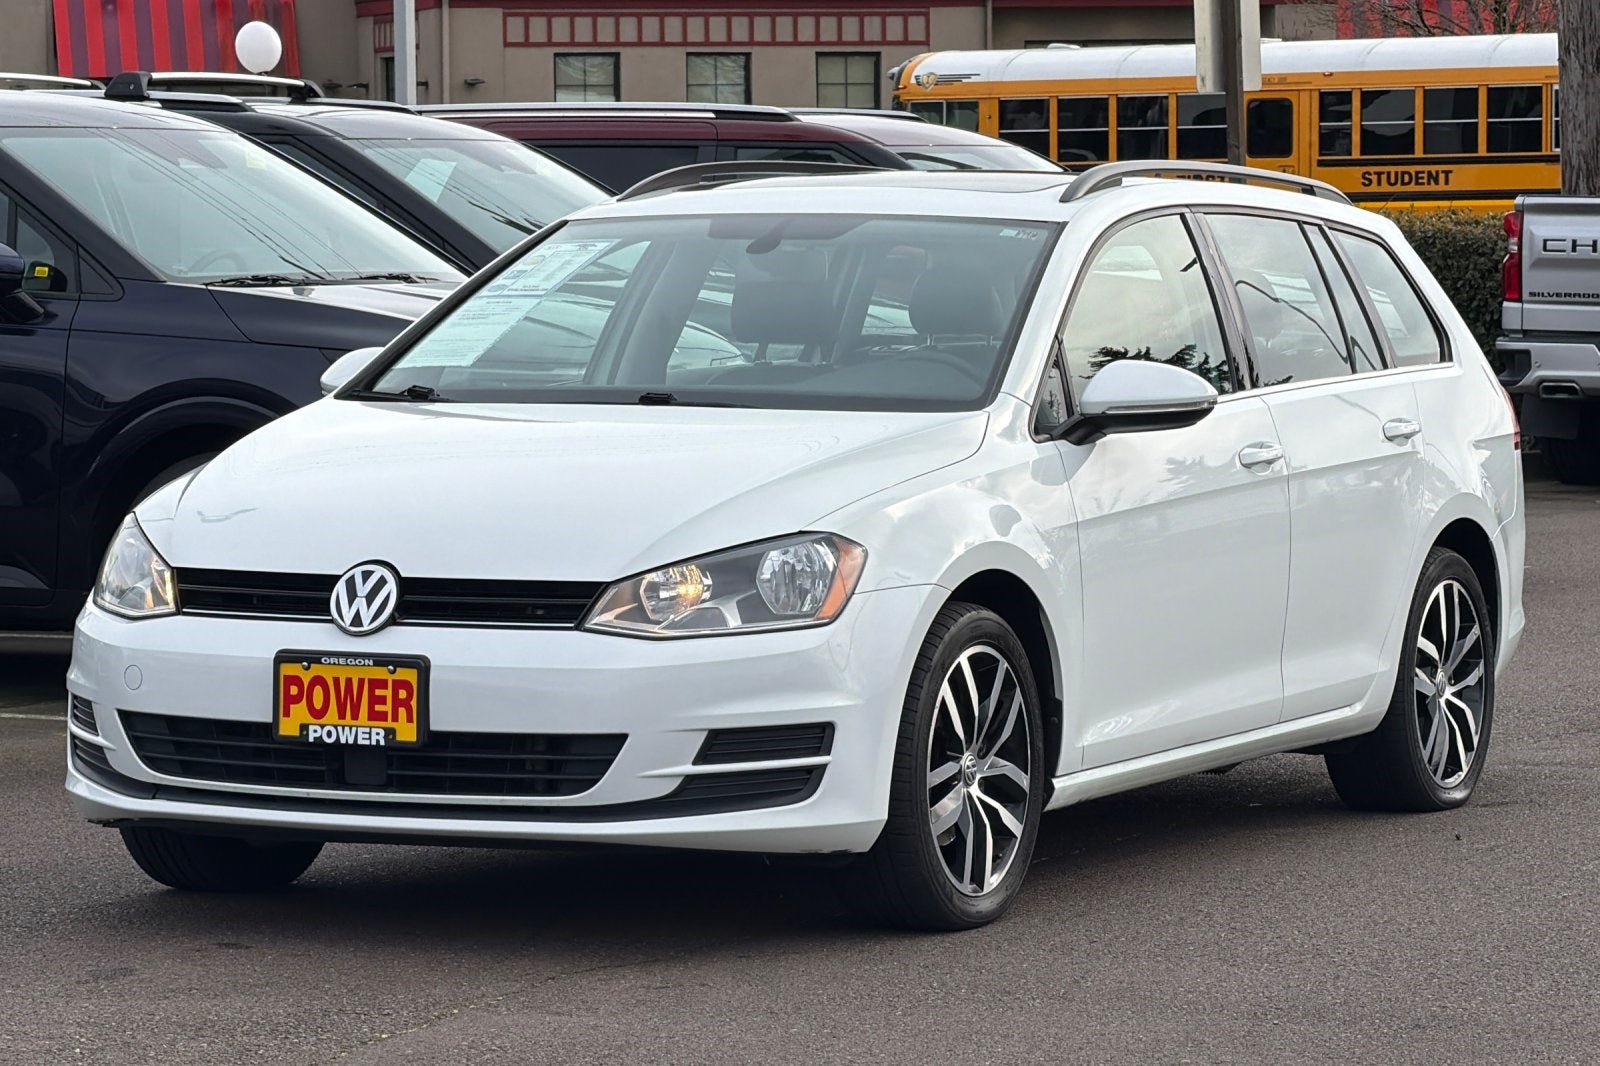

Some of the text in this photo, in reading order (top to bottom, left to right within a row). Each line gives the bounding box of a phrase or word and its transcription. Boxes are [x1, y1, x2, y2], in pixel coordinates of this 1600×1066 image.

[1361, 170, 1453, 187] STUDENT
[1529, 291, 1599, 299] SILVERADO
[331, 565, 397, 631] VW
[321, 657, 374, 666] OREGON
[282, 674, 414, 723] POWER
[308, 724, 386, 746] POWER
